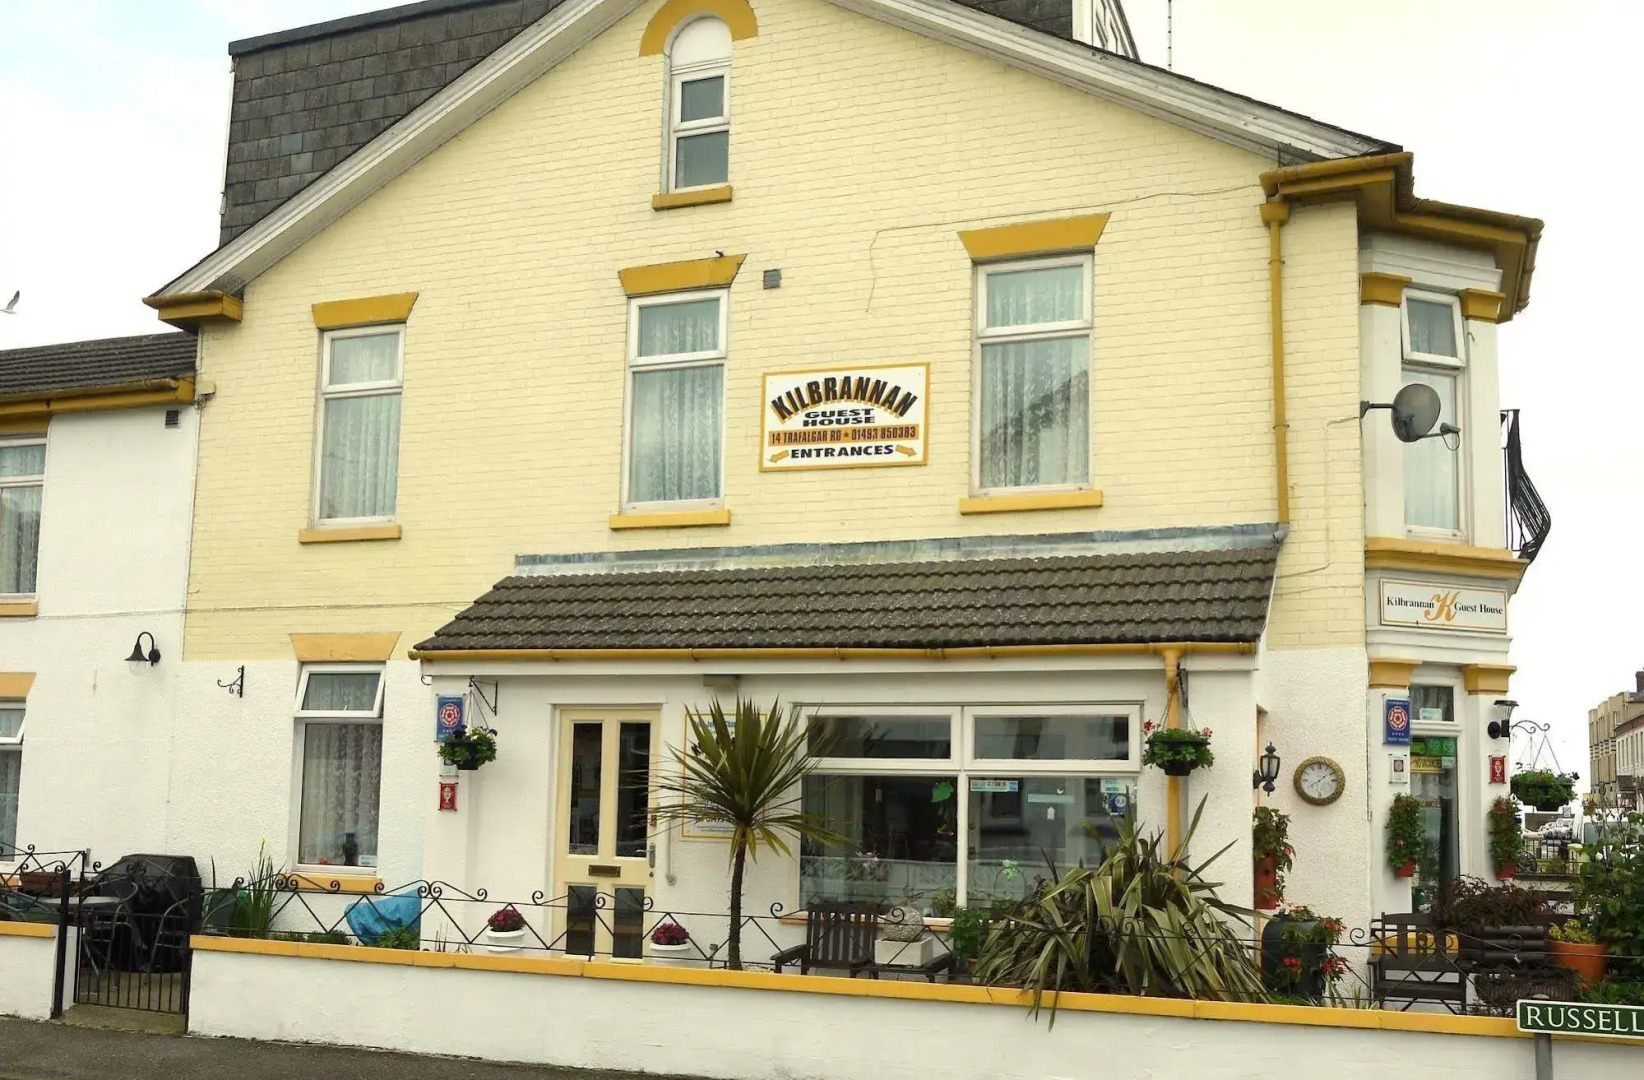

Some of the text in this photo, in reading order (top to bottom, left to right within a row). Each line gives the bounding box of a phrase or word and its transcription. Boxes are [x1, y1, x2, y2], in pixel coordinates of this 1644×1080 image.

[770, 375, 918, 421] KILBRANNAN
[802, 416, 876, 427] HOUSE
[804, 408, 875, 419] GUEST
[771, 426, 916, 444] 14 TRAFALGAR RD 01493 850383
[791, 444, 894, 459] ENTRANCES
[1387, 596, 1435, 609] Kilbrannan
[1454, 602, 1477, 613] Guest
[1479, 603, 1504, 615] House
[1526, 1005, 1644, 1033] RUSSELL
